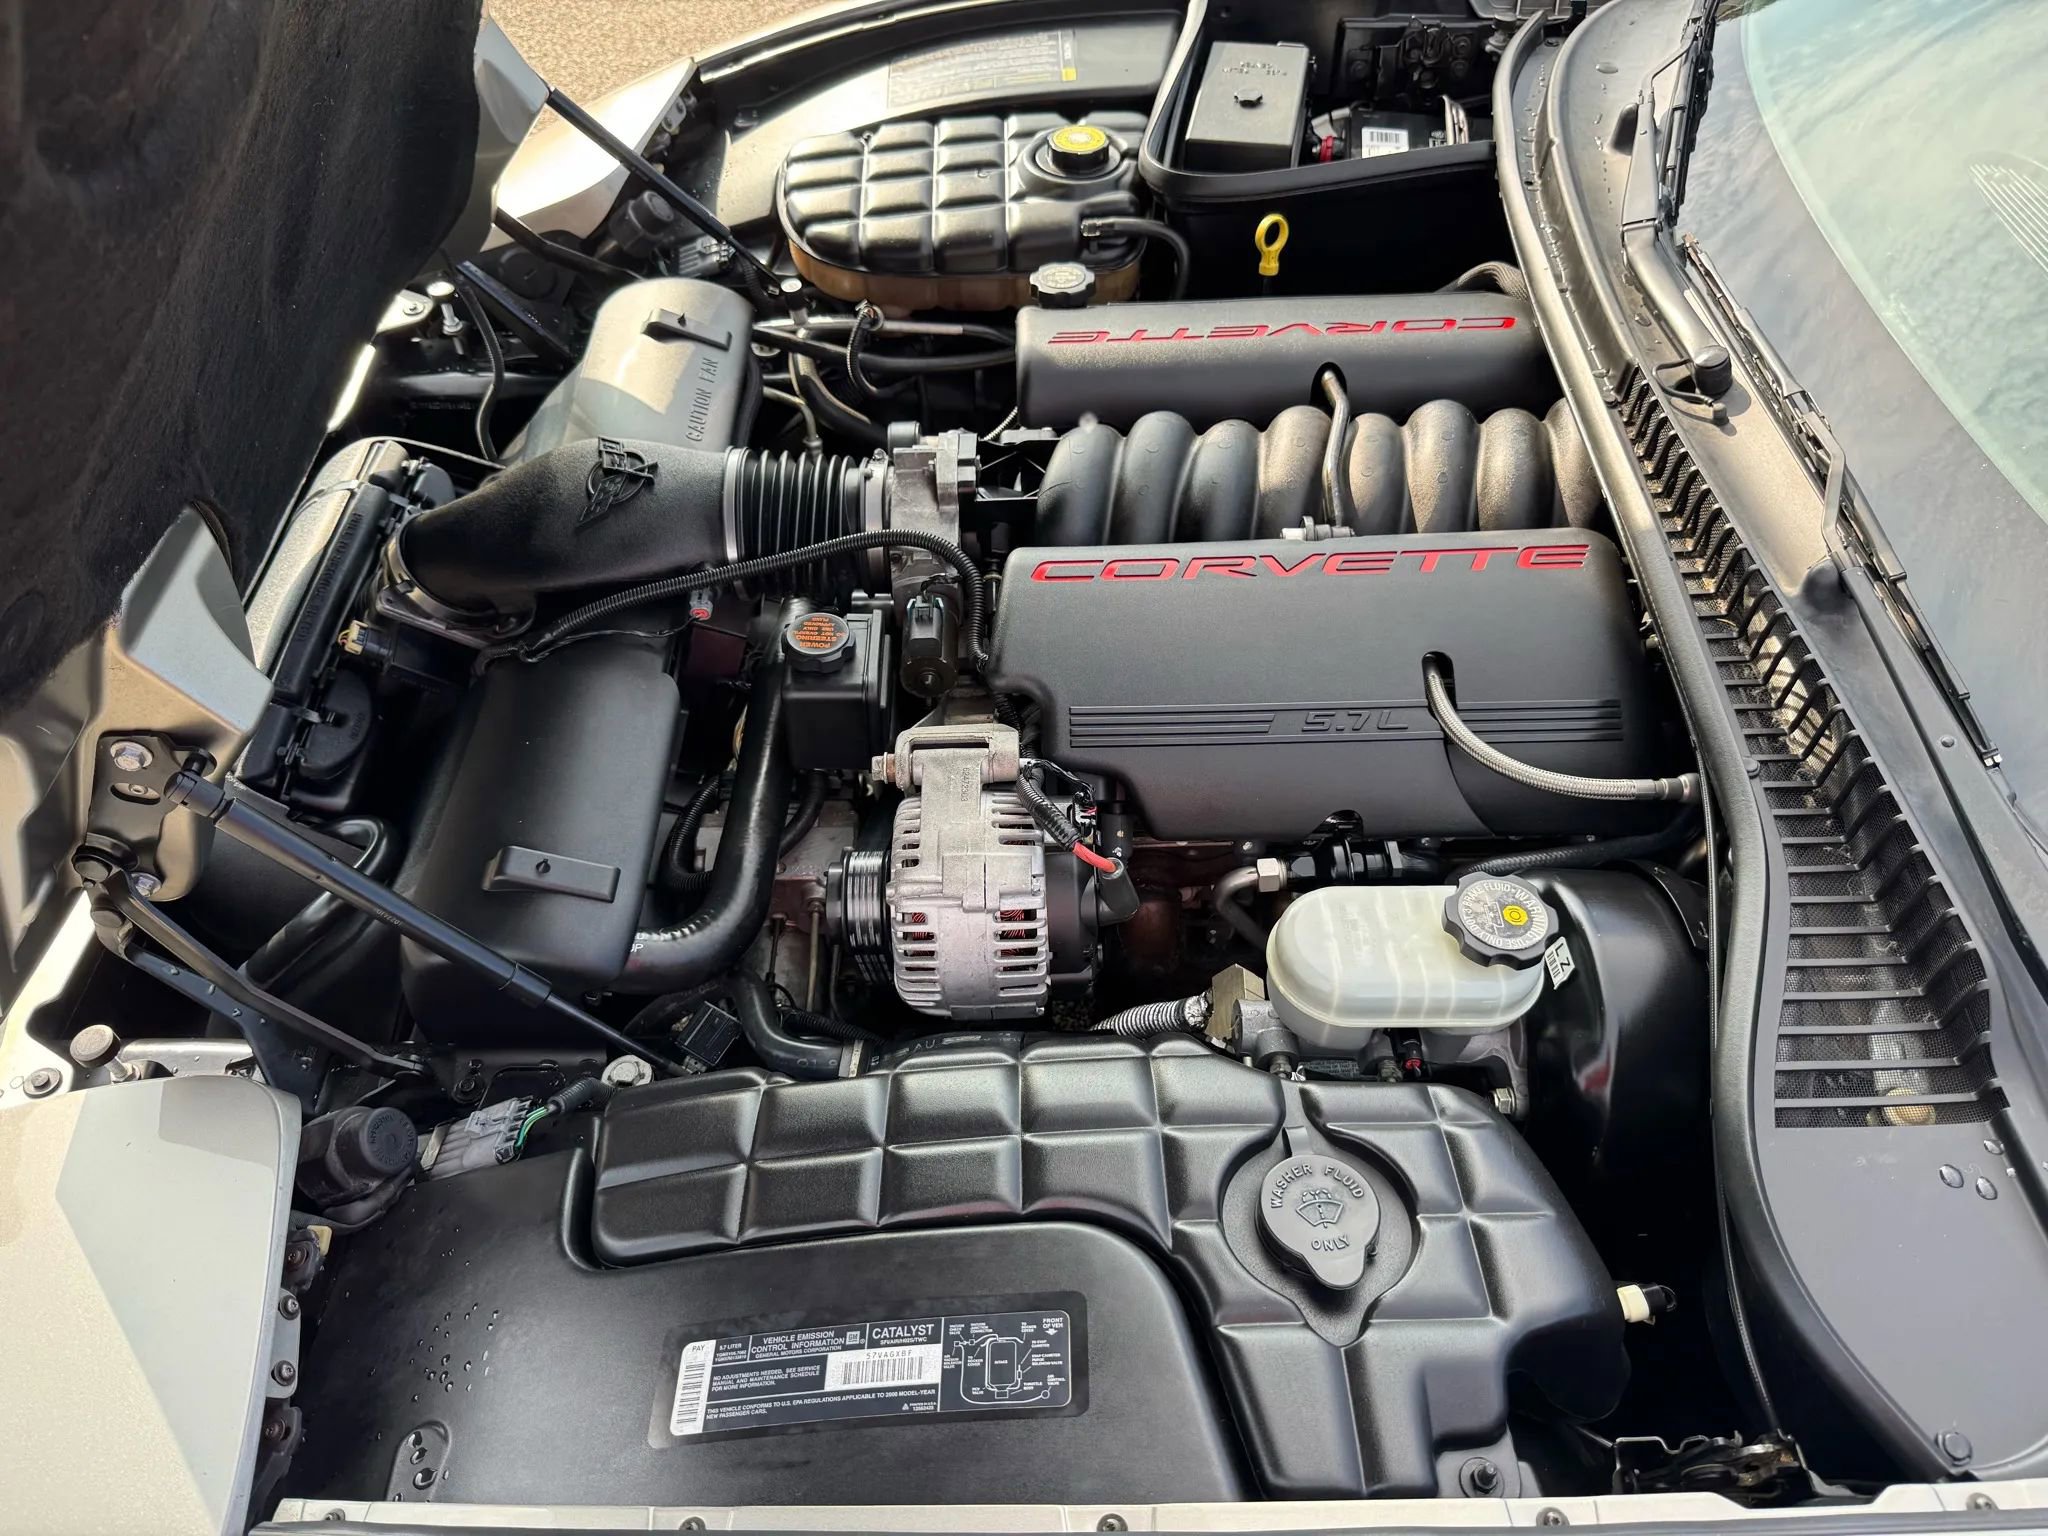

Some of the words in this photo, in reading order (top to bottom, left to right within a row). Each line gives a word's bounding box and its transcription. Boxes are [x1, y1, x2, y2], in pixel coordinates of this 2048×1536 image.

[1048, 316, 1518, 344] CORVETTE
[698, 357, 719, 384] FAN
[685, 387, 712, 442] CAUTION
[1031, 543, 1591, 583] CORVETTE
[1301, 711, 1410, 732] 5.7L
[1270, 1163, 1313, 1209] WASHER
[1323, 1165, 1365, 1199] FLUID
[1311, 1235, 1351, 1251] ONLY
[763, 1334, 796, 1344] VEHICLE
[797, 1330, 835, 1342] EMISSION
[872, 1324, 935, 1340] CATALYST
[692, 1344, 706, 1352] PAY
[751, 1343, 788, 1354] CONTROL
[791, 1338, 845, 1350] INFORMATION
[803, 1345, 842, 1354] CORPORATION
[722, 1371, 760, 1380] ADJUSTMENTS
[749, 1373, 788, 1382] MAINTENANCE
[789, 1370, 820, 1378] SCHEDULE
[719, 1405, 741, 1413] VEHICLE
[742, 1402, 773, 1410] CONFORMS
[803, 1396, 841, 1405] REGULATIONS
[841, 1393, 876, 1401] APPLICABLE
[899, 1389, 936, 1397] MODEL-YEAR
[719, 1410, 750, 1418] PASSENGER
